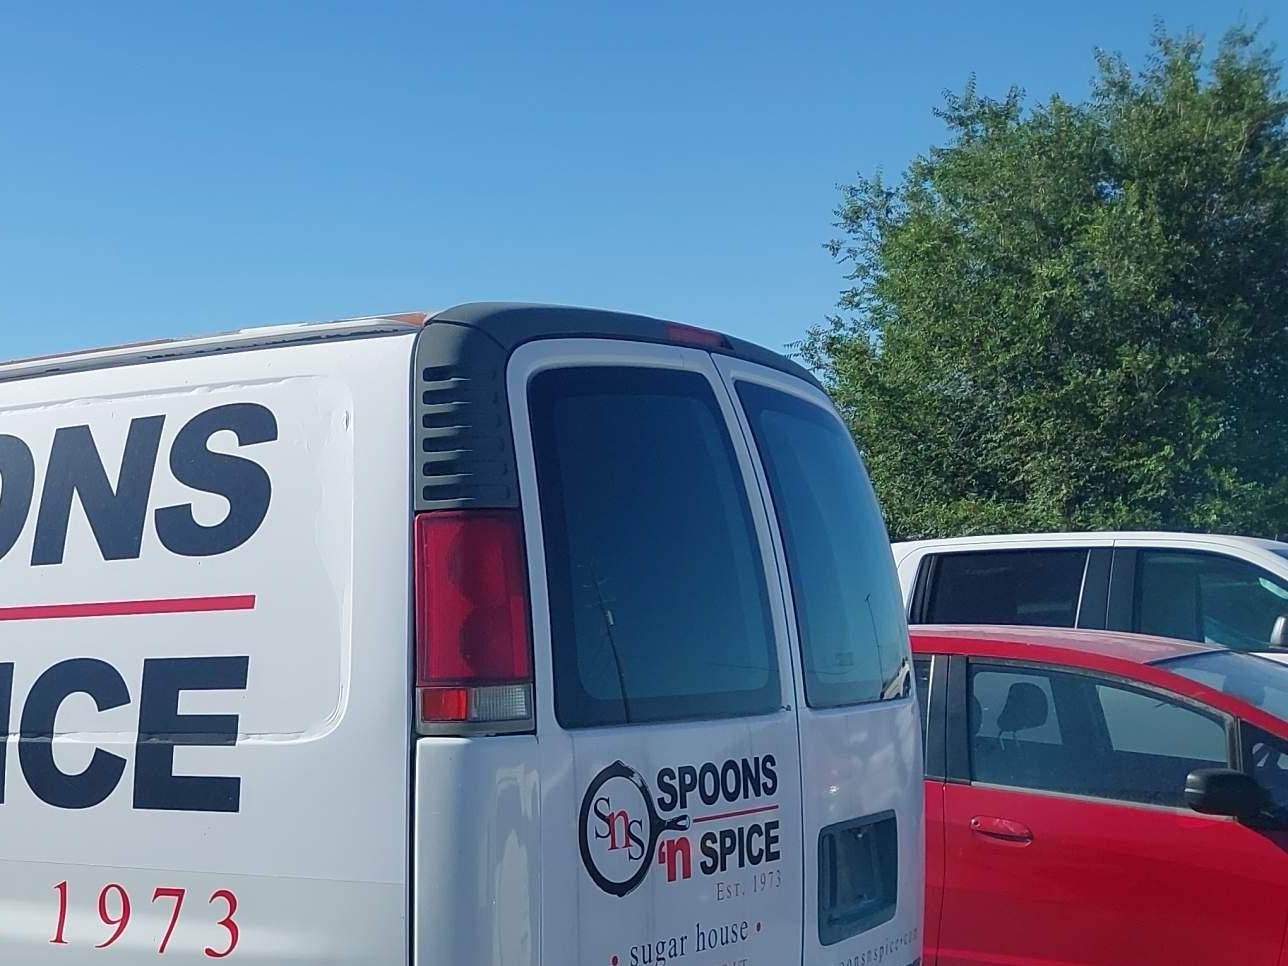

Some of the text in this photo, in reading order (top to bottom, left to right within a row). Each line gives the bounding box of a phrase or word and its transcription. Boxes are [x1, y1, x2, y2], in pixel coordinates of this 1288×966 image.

[656, 754, 778, 813] SPOONS
[592, 795, 646, 862] SnS
[699, 820, 781, 875] SPICE
[752, 870, 782, 893] 1973
[50, 879, 241, 959] 1973
[696, 920, 749, 953] house
